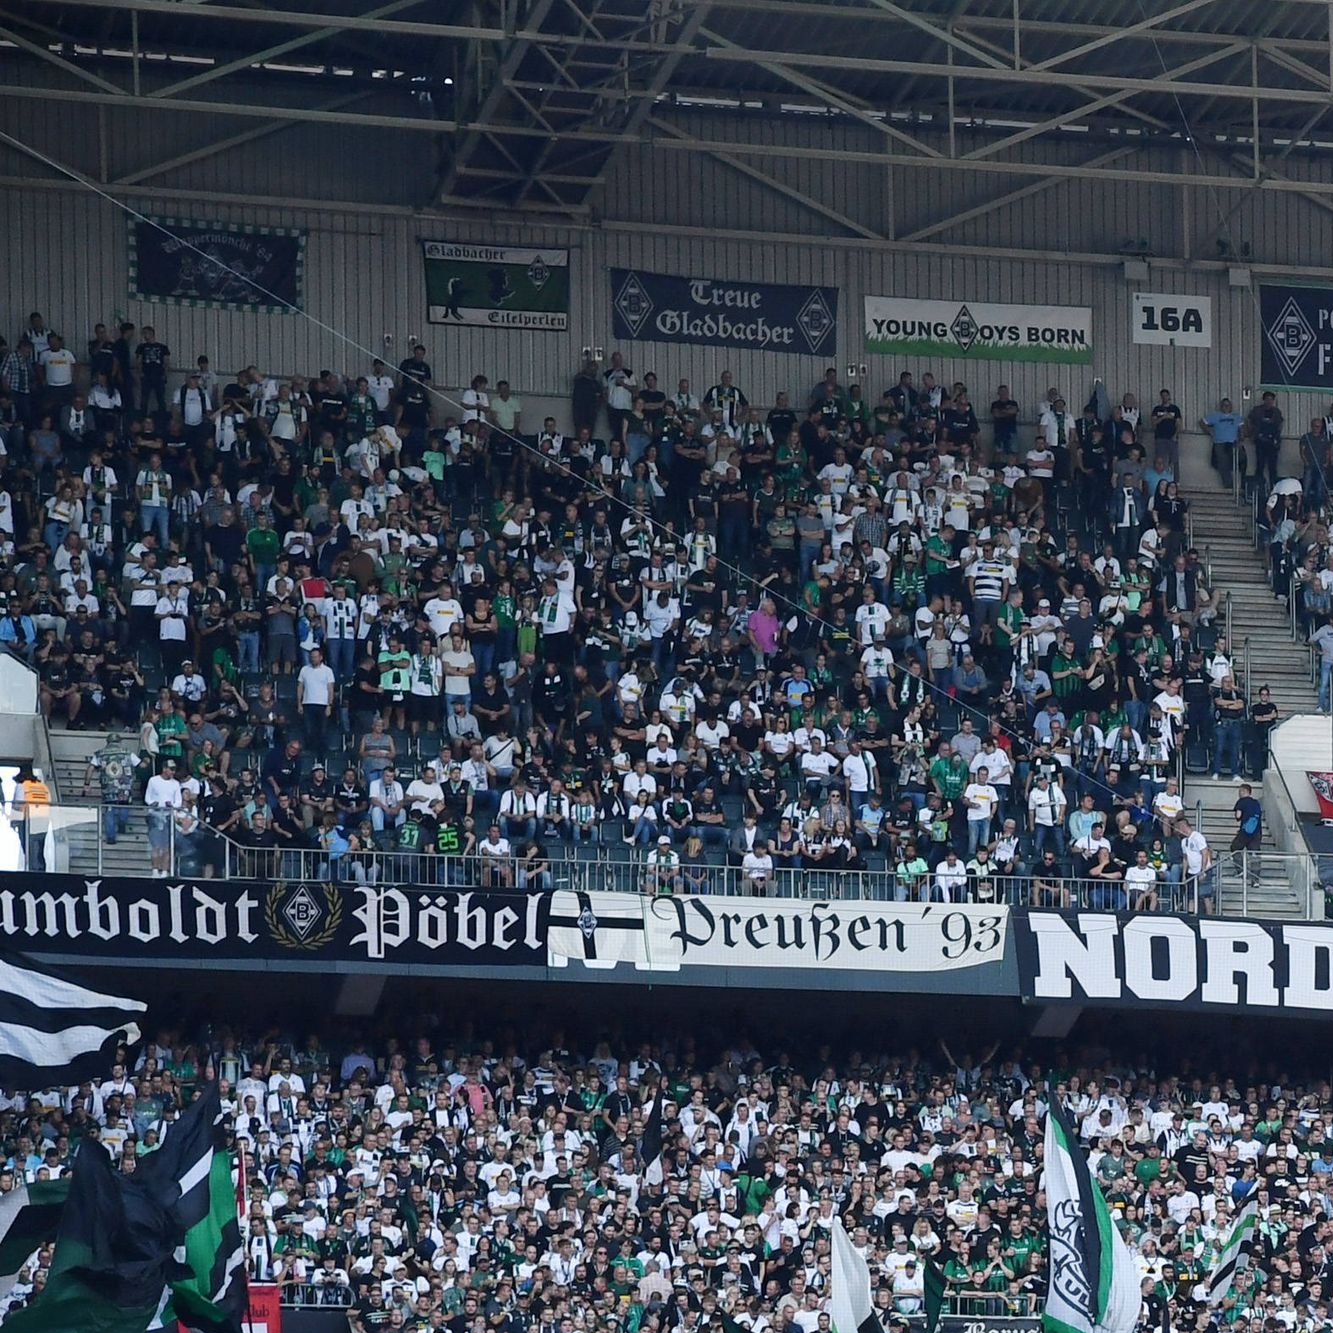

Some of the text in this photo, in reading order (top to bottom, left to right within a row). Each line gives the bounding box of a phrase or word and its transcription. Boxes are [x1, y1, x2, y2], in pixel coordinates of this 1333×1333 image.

[427, 243, 504, 260] Gladbacher
[689, 280, 762, 309] Treue
[488, 312, 565, 327] Eifelperlen
[656, 309, 794, 347] Gladbacher
[873, 318, 947, 338] YOUNG
[1027, 326, 1085, 345] BORN
[1141, 306, 1203, 333] 16A
[400, 827, 419, 847] 31
[350, 885, 545, 959] Pöbel
[650, 895, 906, 962] Preußen
